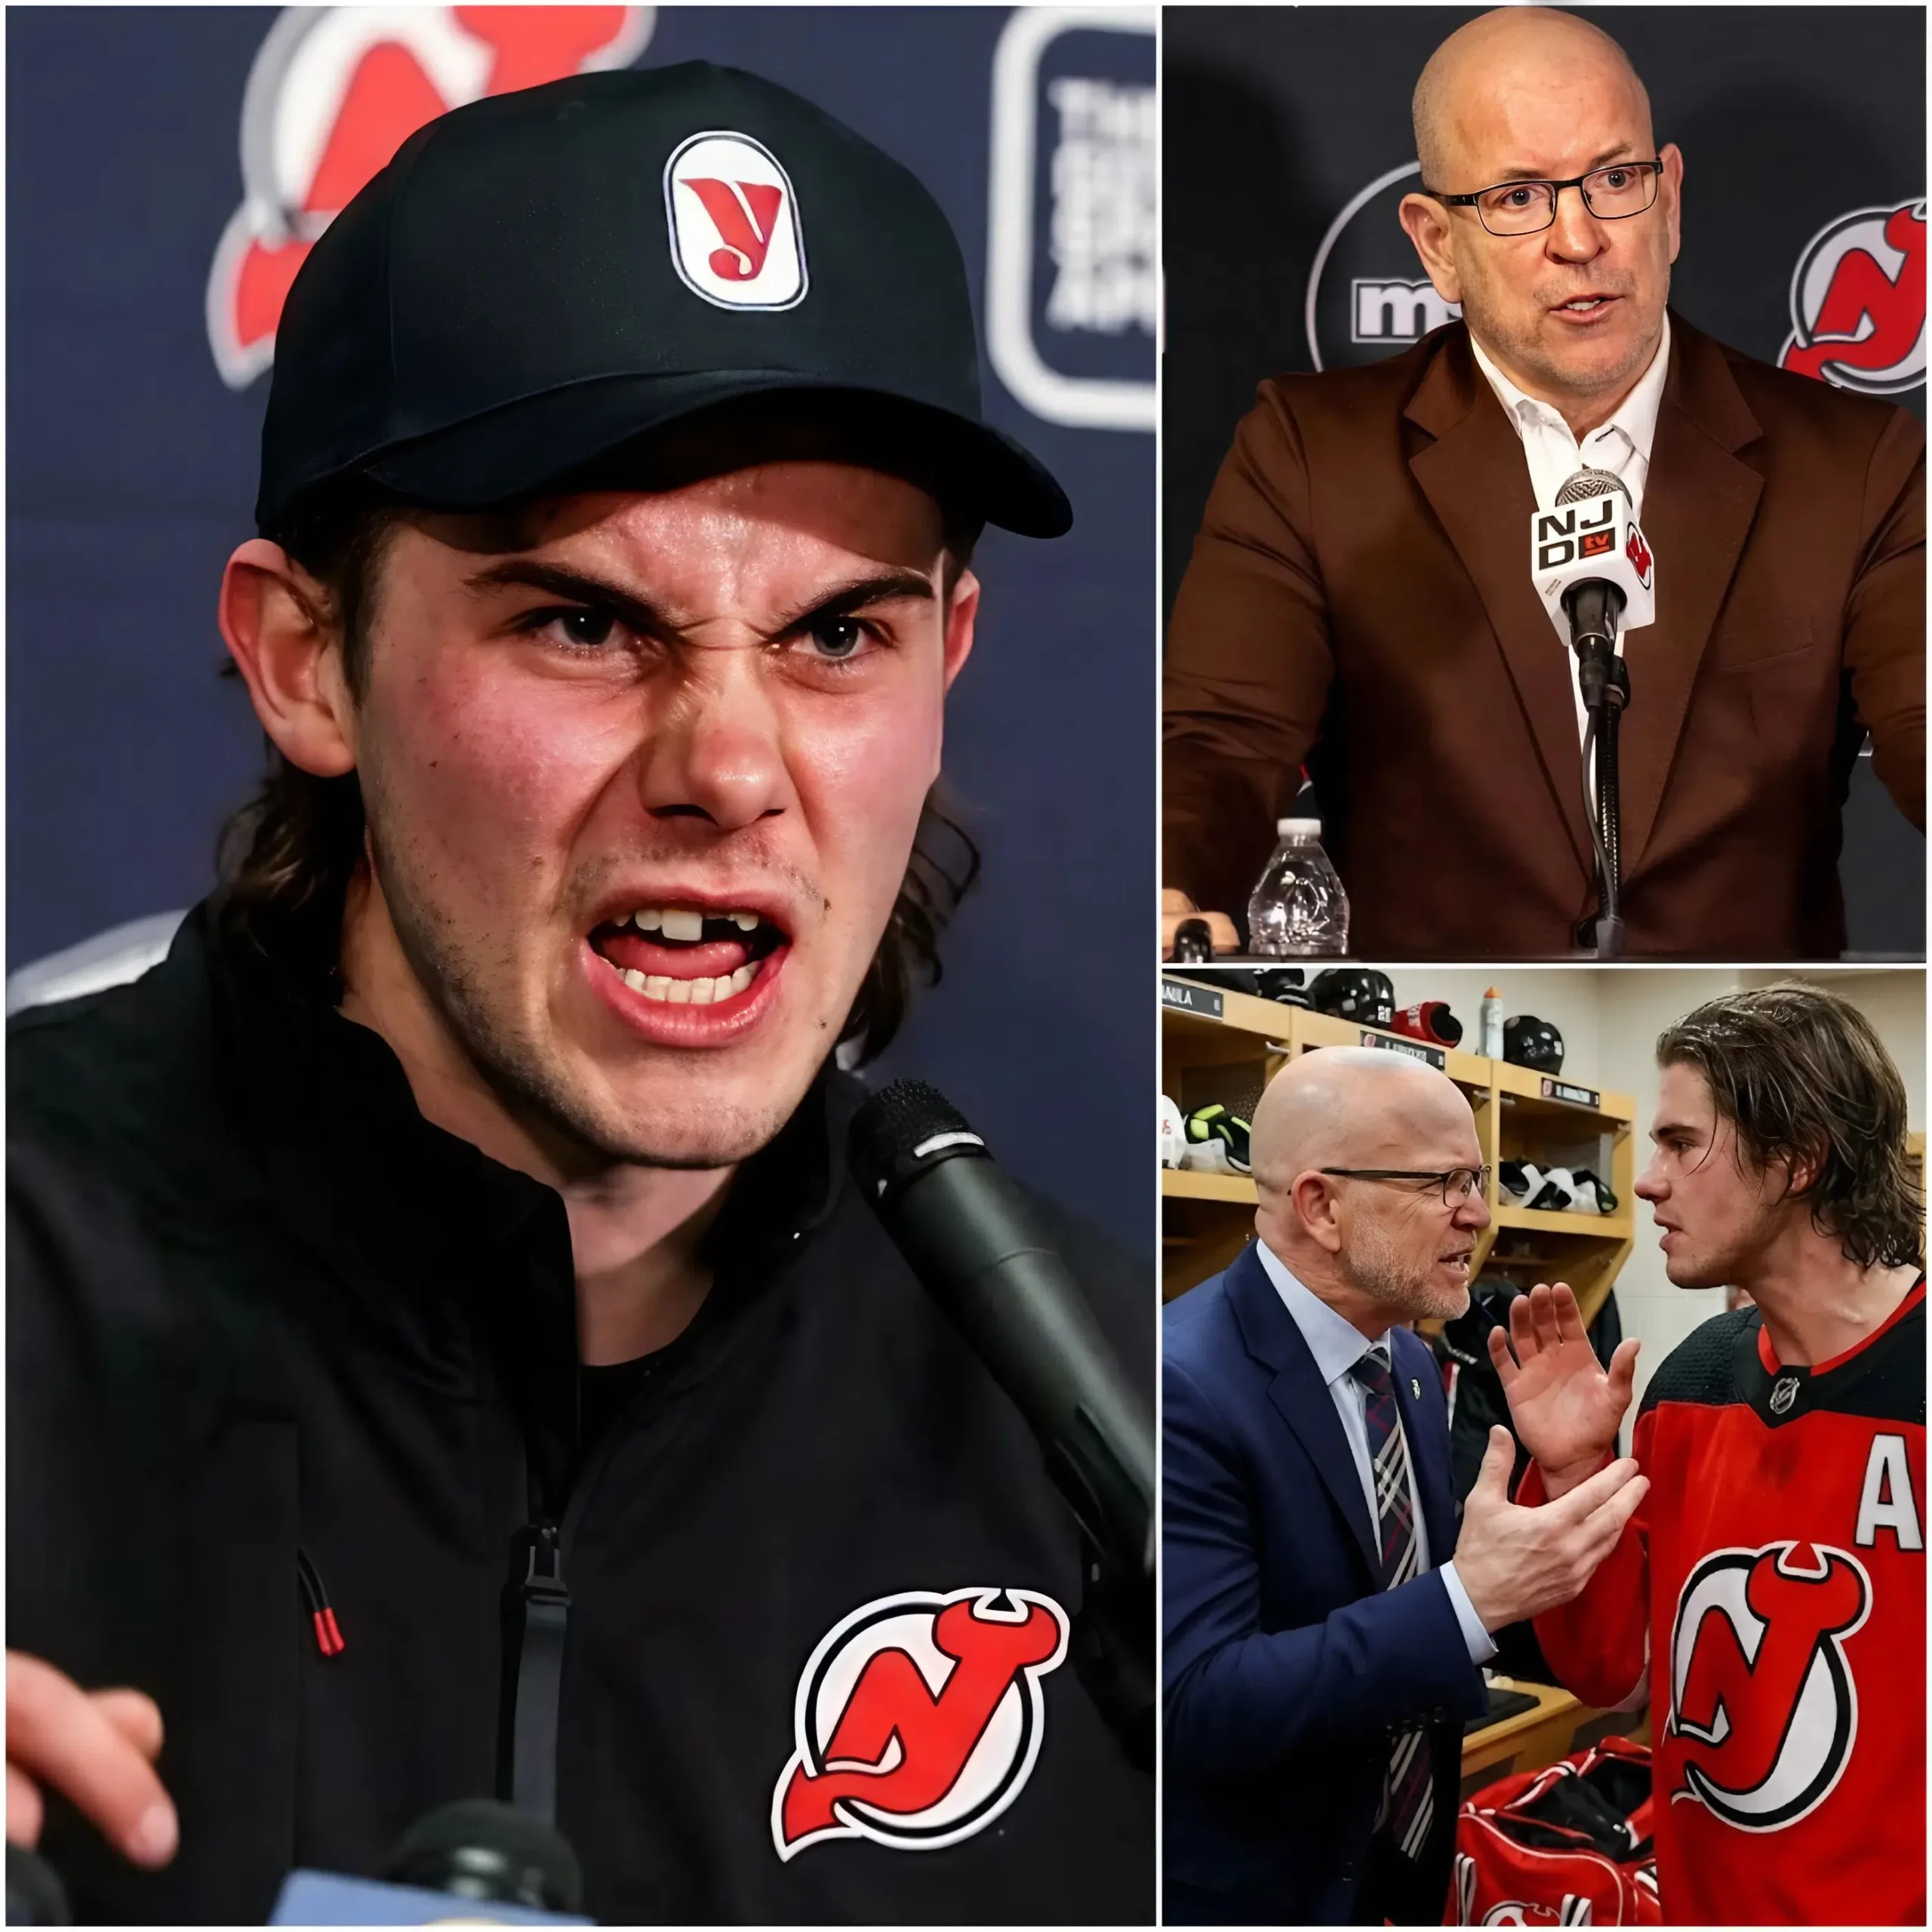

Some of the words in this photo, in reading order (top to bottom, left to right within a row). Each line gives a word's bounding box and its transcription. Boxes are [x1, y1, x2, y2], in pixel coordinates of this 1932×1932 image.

[1358, 284, 1463, 336] m
[1538, 499, 1613, 543] NJ
[1538, 540, 1574, 571] D
[1855, 1434, 1924, 1550] A
